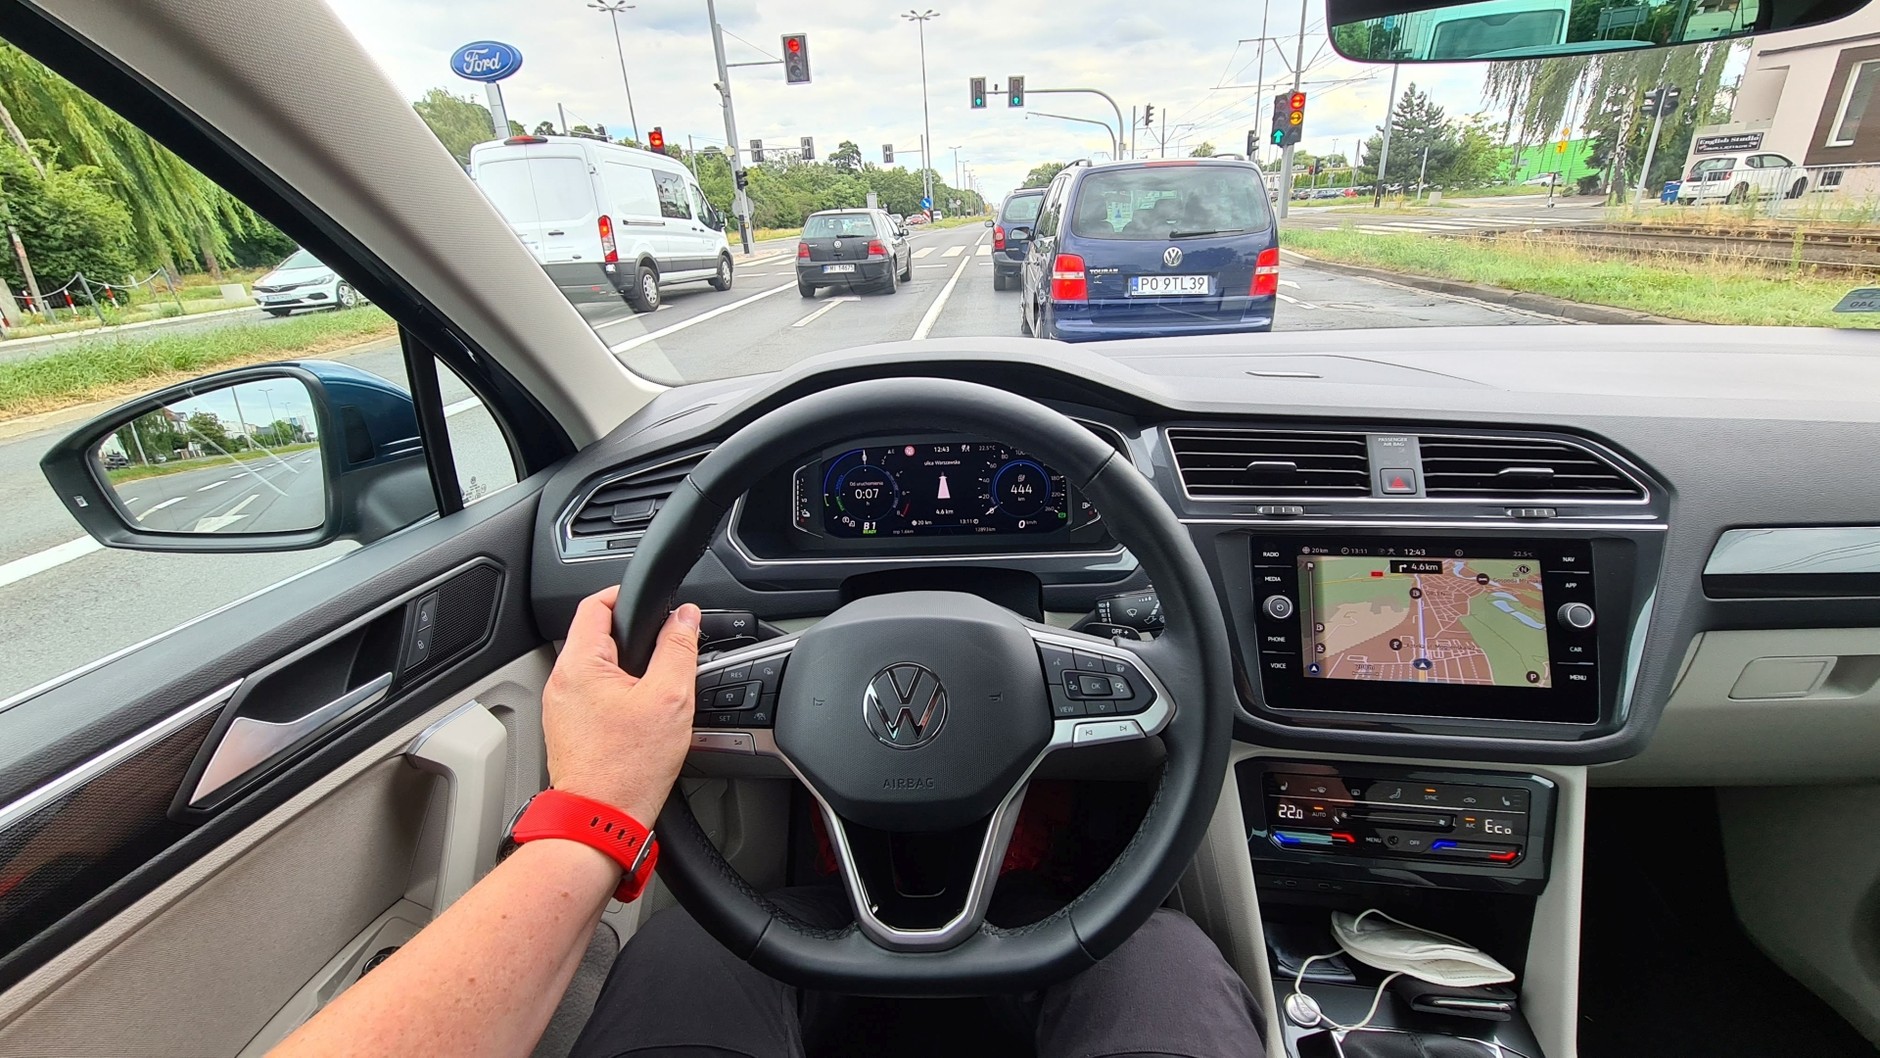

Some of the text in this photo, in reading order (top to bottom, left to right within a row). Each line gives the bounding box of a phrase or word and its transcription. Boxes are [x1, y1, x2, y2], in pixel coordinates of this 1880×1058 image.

[463, 48, 501, 74] Ford
[1700, 134, 1759, 145] English Studio
[1163, 276, 1205, 290] 9TL39
[855, 488, 879, 499] 0:07
[1010, 484, 1033, 494] 444
[1018, 520, 1026, 529] 0
[1404, 548, 1426, 556] 12:43
[882, 777, 935, 790] AIRBAG
[1484, 819, 1512, 835] Eco
